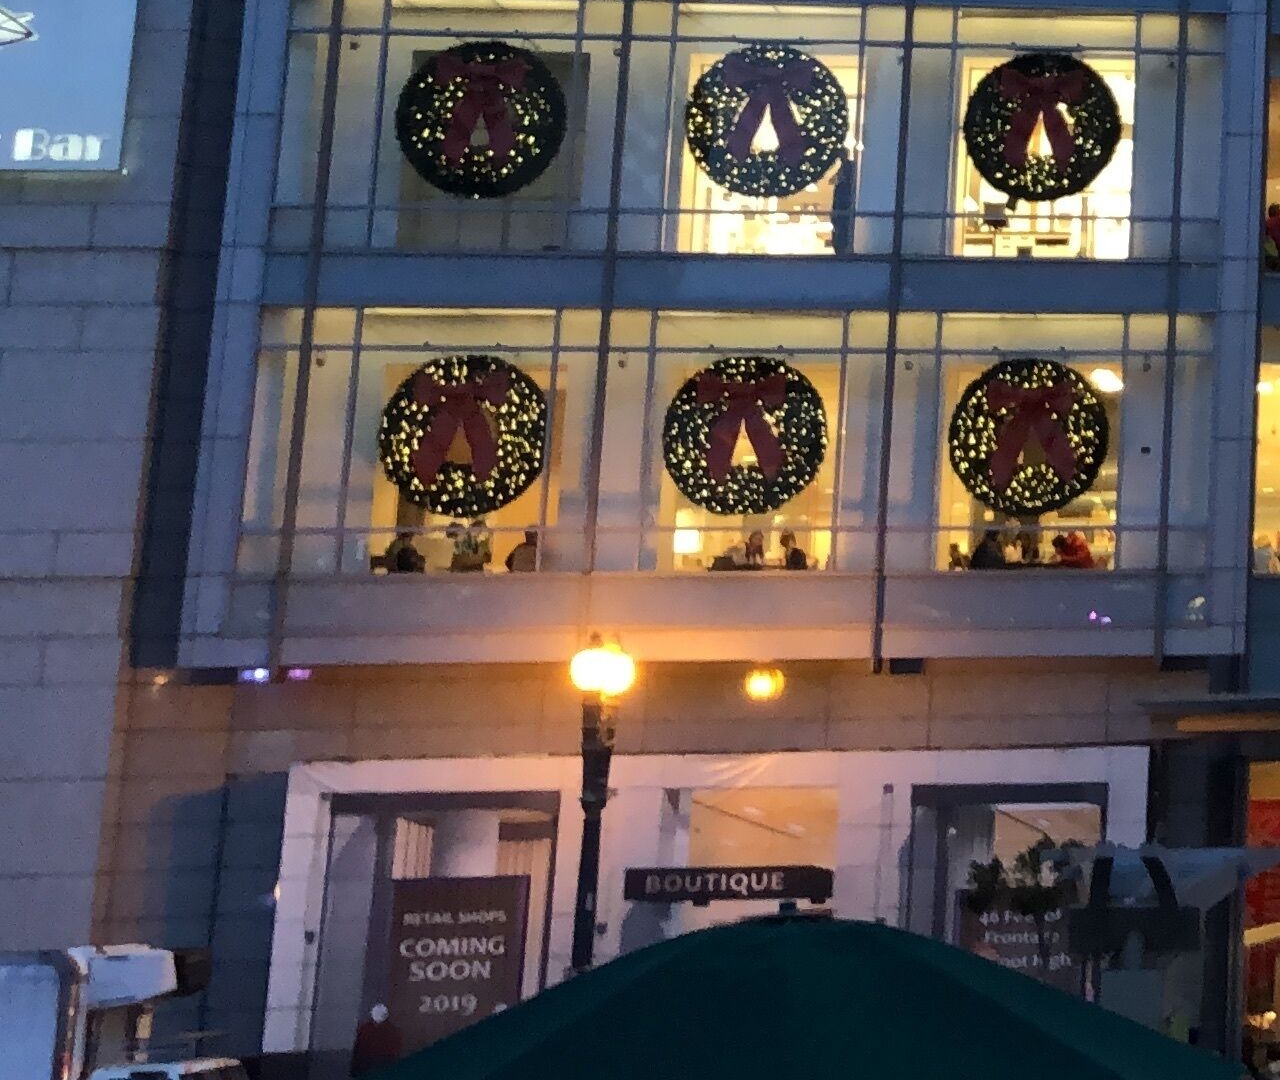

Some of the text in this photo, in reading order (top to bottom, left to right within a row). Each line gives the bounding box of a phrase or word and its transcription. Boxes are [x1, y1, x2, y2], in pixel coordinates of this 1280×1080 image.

[13, 129, 112, 161] Bar
[645, 871, 785, 896] BOUTIQUE
[399, 935, 506, 958] COMING
[408, 958, 493, 983] SOON
[418, 992, 479, 1017] 2019
